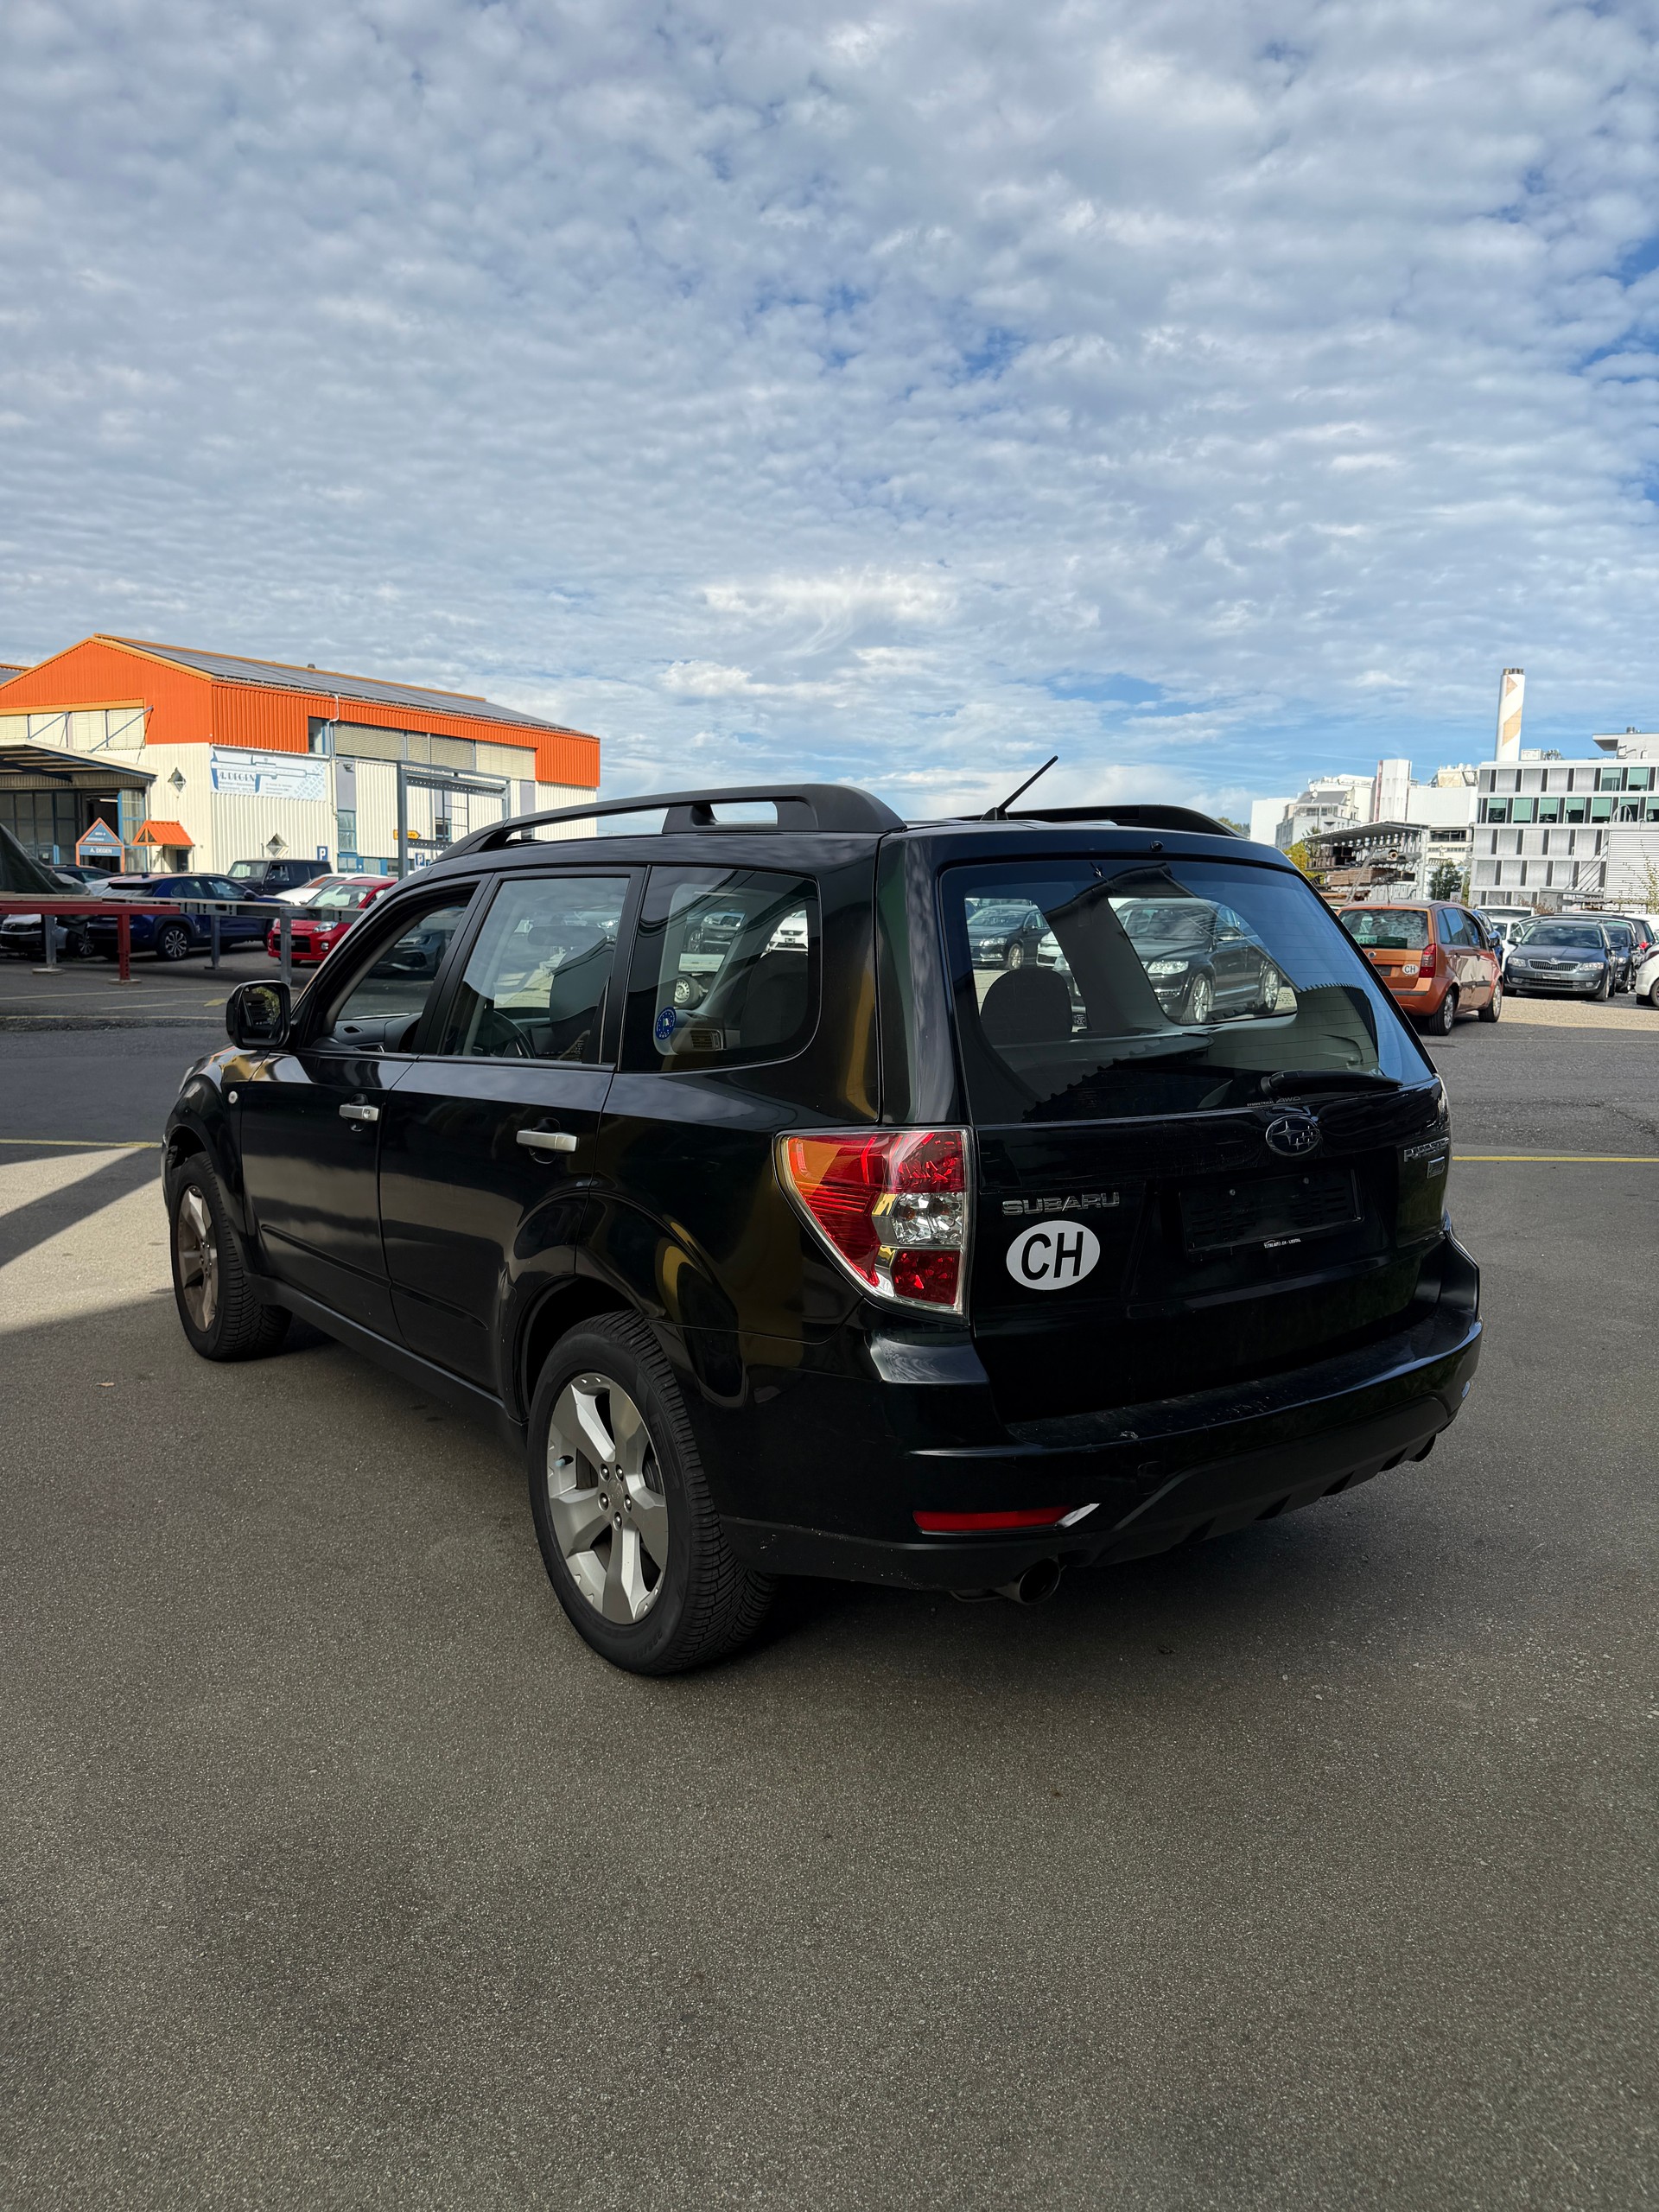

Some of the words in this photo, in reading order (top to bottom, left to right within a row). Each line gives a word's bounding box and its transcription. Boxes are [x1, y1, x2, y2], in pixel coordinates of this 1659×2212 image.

[228, 772, 255, 782] DEGEN
[319, 848, 327, 861] P
[416, 854, 423, 865] P
[1404, 965, 1416, 974] CH
[1002, 1192, 1120, 1216] SUBARU
[1021, 1231, 1084, 1281] CH
